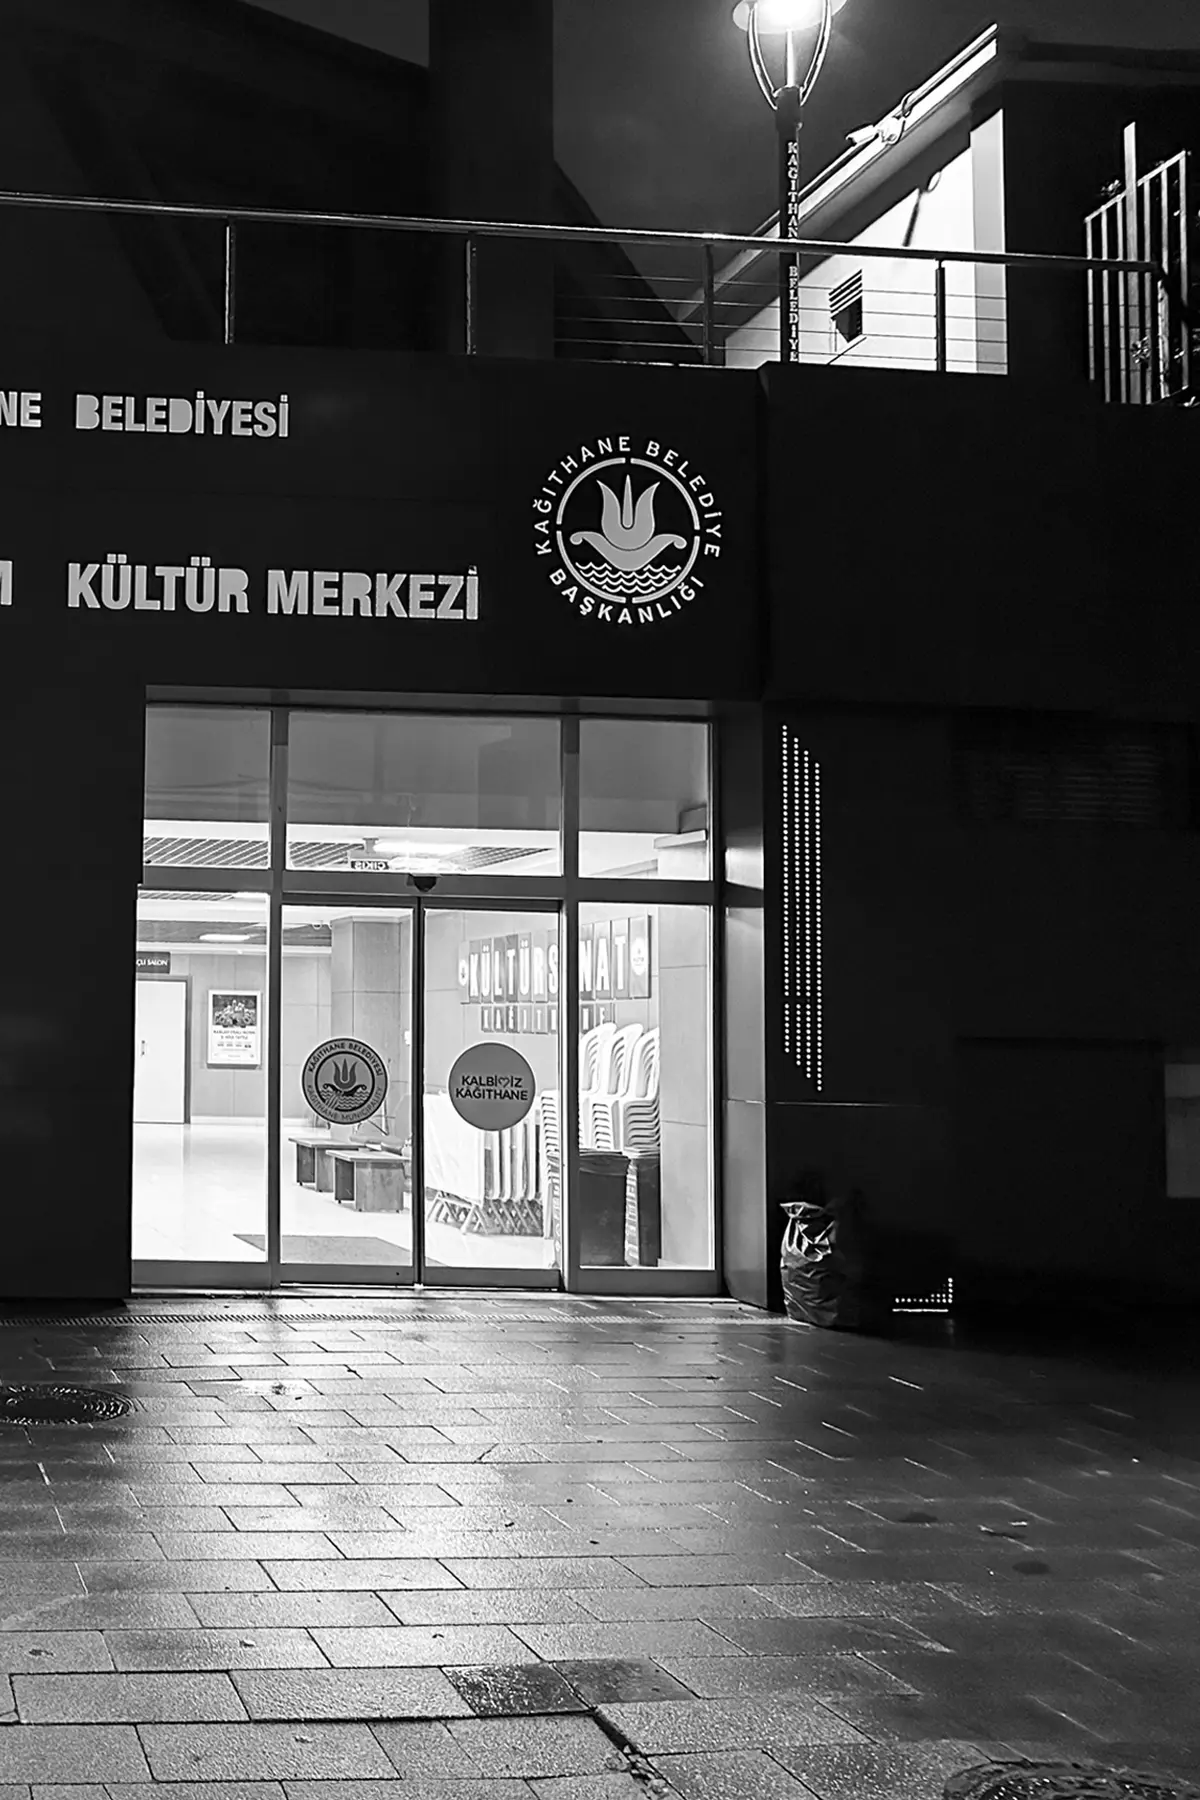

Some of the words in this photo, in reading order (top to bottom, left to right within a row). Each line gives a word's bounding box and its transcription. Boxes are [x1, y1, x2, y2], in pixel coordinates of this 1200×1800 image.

[76, 391, 289, 438] BELEDİYESİ
[532, 436, 631, 555] KAĞITHANE
[645, 441, 722, 557] BELEDİYE
[67, 553, 250, 614] KÜLTÜR
[267, 565, 479, 621] MERKEZİ
[549, 568, 704, 624] BAŞKANLIĞI
